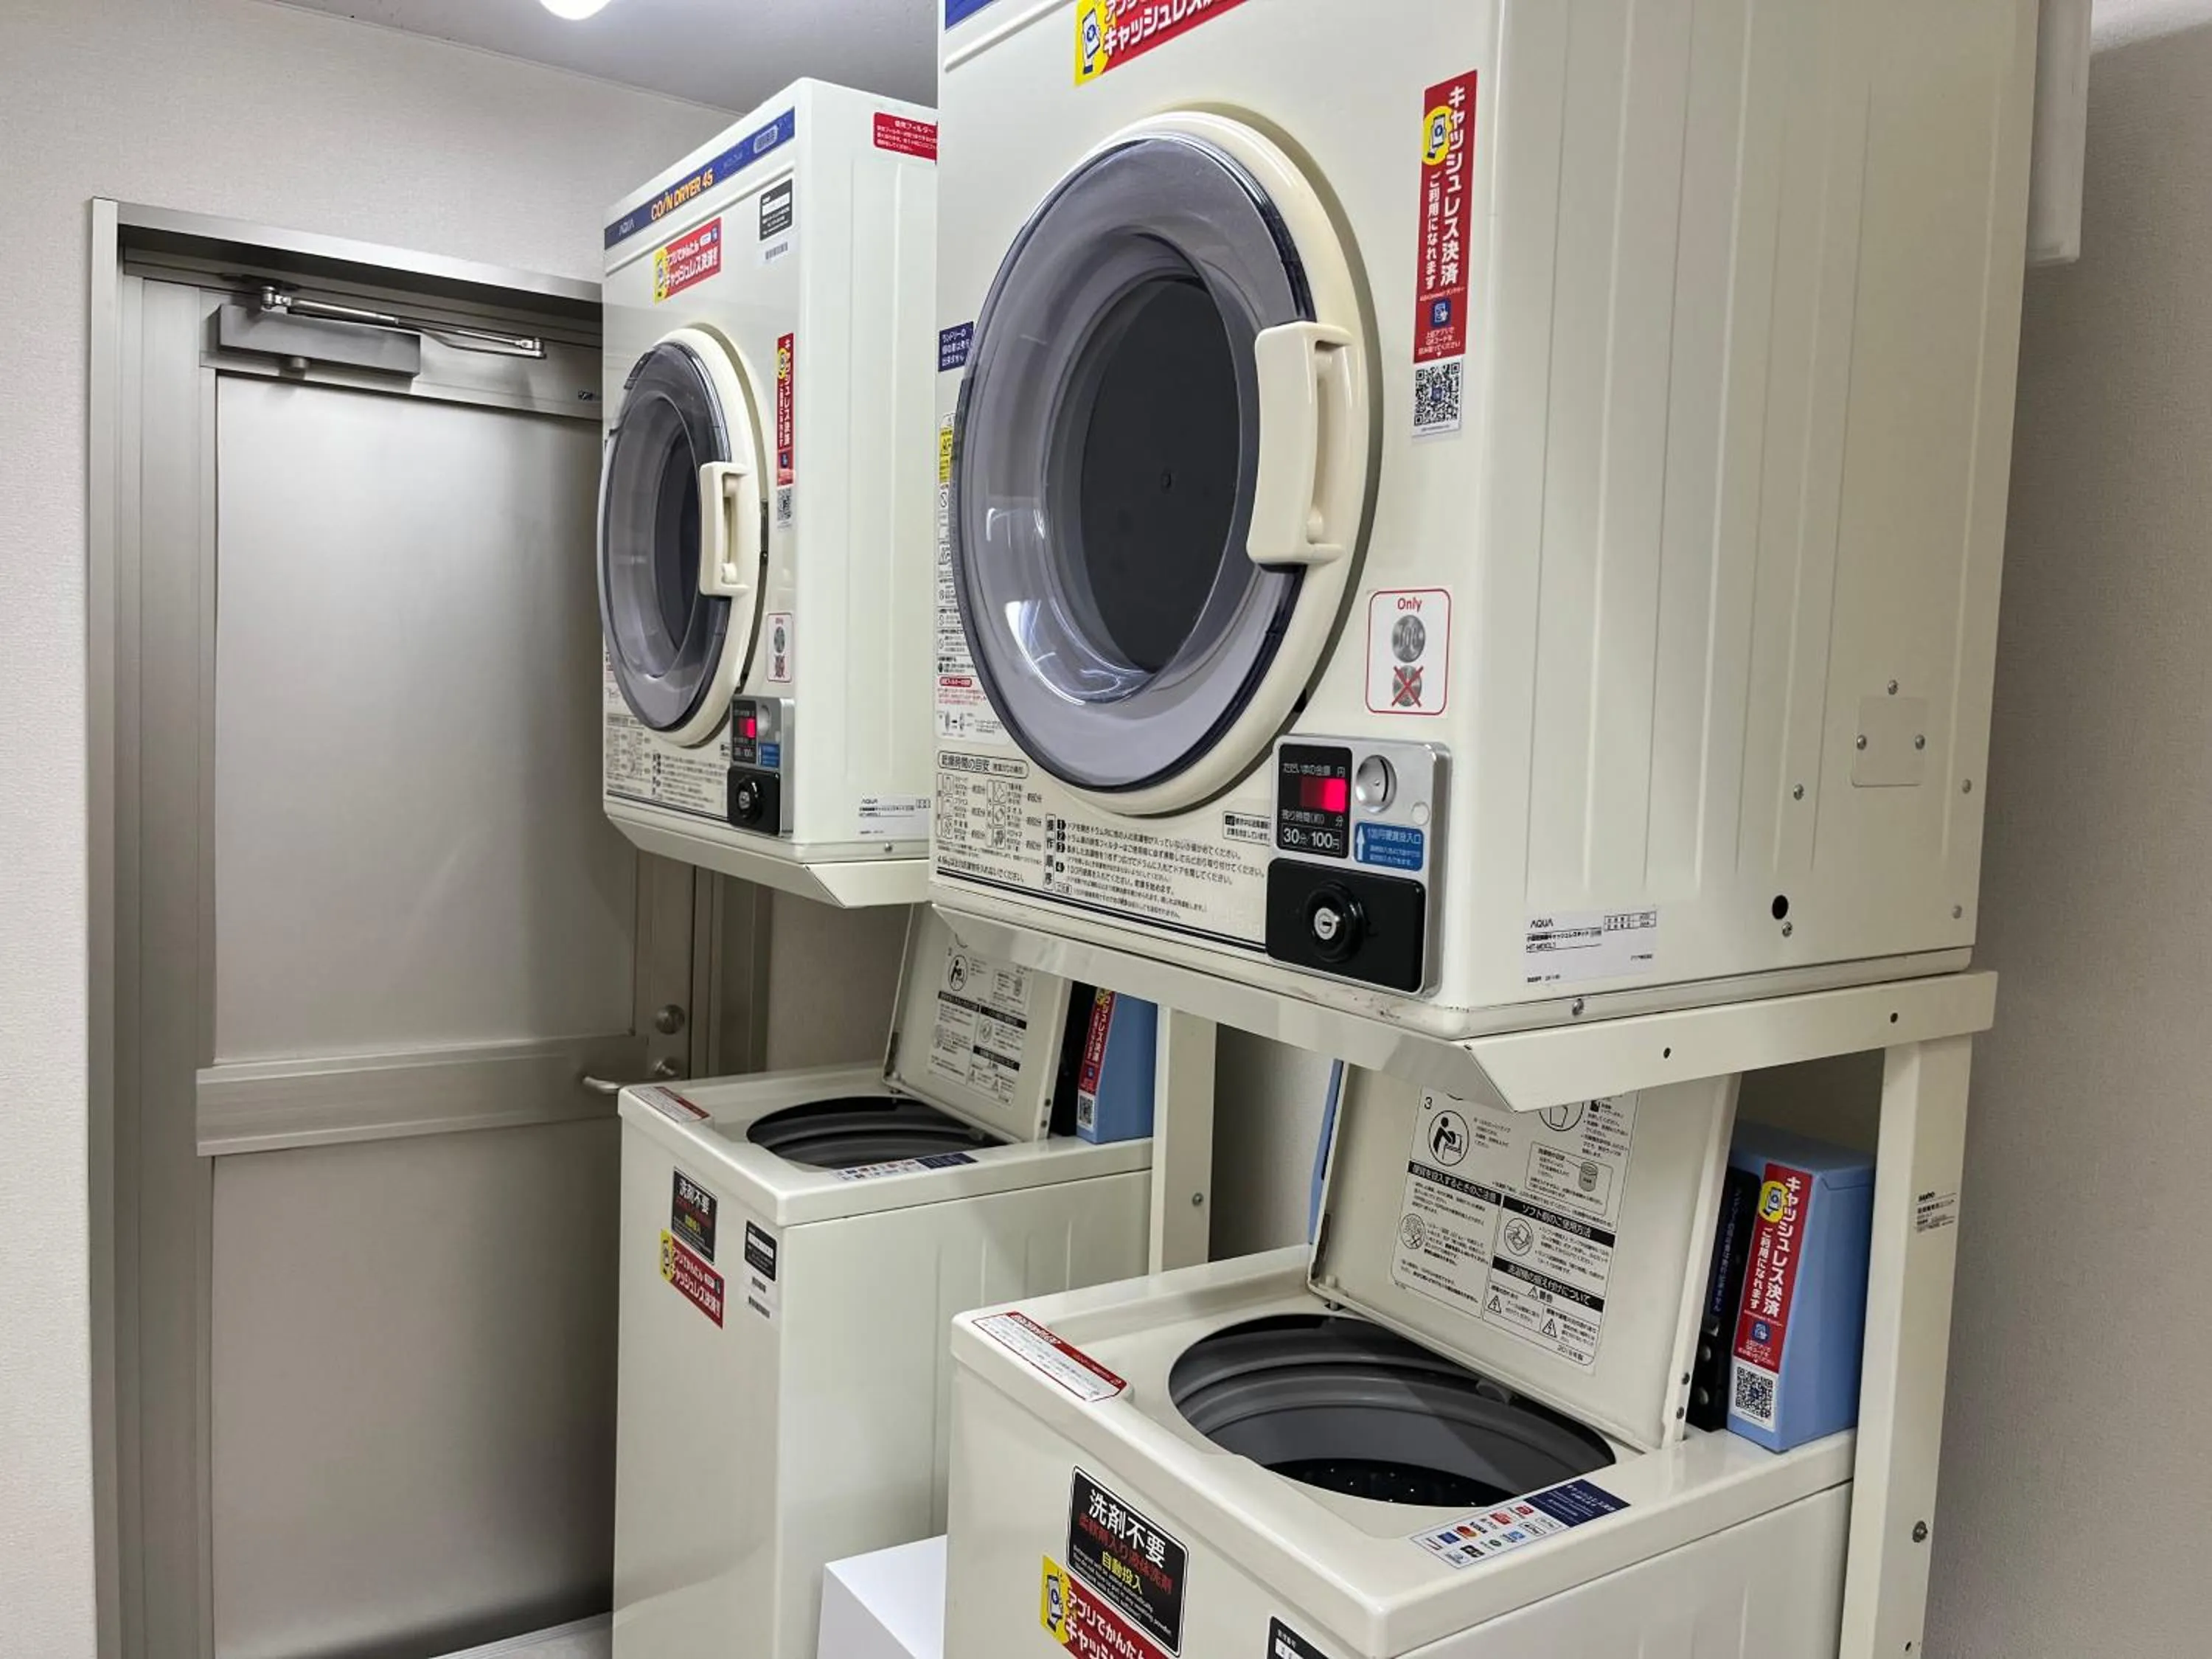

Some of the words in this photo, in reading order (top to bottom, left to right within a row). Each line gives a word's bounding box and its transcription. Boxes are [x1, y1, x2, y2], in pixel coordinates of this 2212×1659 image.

[652, 190, 674, 220] COIN
[674, 176, 700, 207] DRYER
[1441, 86, 1466, 286] キャッシュレス決済
[1397, 597, 1422, 613] Only
[1530, 918, 1554, 928] AQUA
[1424, 1096, 1433, 1110] 3
[1763, 1176, 1801, 1318] キャッシュレス決済
[1088, 1488, 1166, 1569] 洗剤不要
[1102, 1550, 1143, 1595] 自動投入
